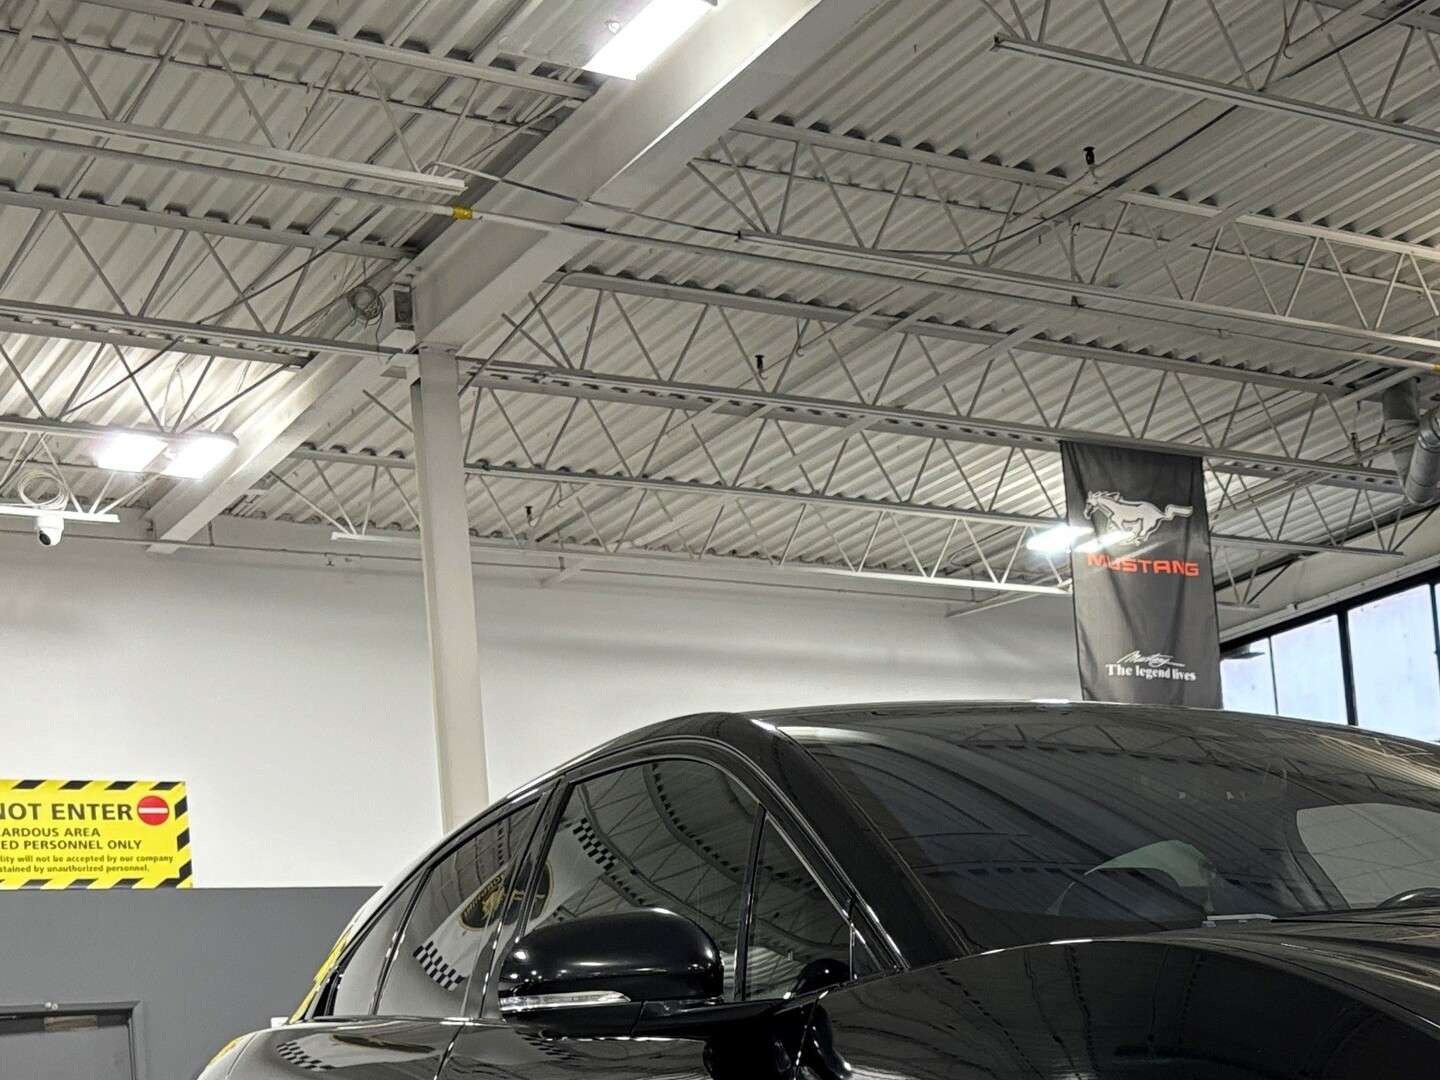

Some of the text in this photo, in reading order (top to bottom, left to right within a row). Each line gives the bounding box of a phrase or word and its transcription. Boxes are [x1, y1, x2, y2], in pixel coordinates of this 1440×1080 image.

[1087, 553, 1200, 577] MUSTANG
[1105, 664, 1197, 681] The legend lives
[52, 803, 133, 820] ENTER
[1, 827, 101, 837] ARDOUS AREA
[1, 840, 142, 850] ED PERSONNEL ONLY
[66, 855, 104, 864] accepted
[107, 855, 117, 864] by
[136, 856, 174, 864] company
[34, 865, 44, 874] by
[47, 865, 103, 873] unauthorized
